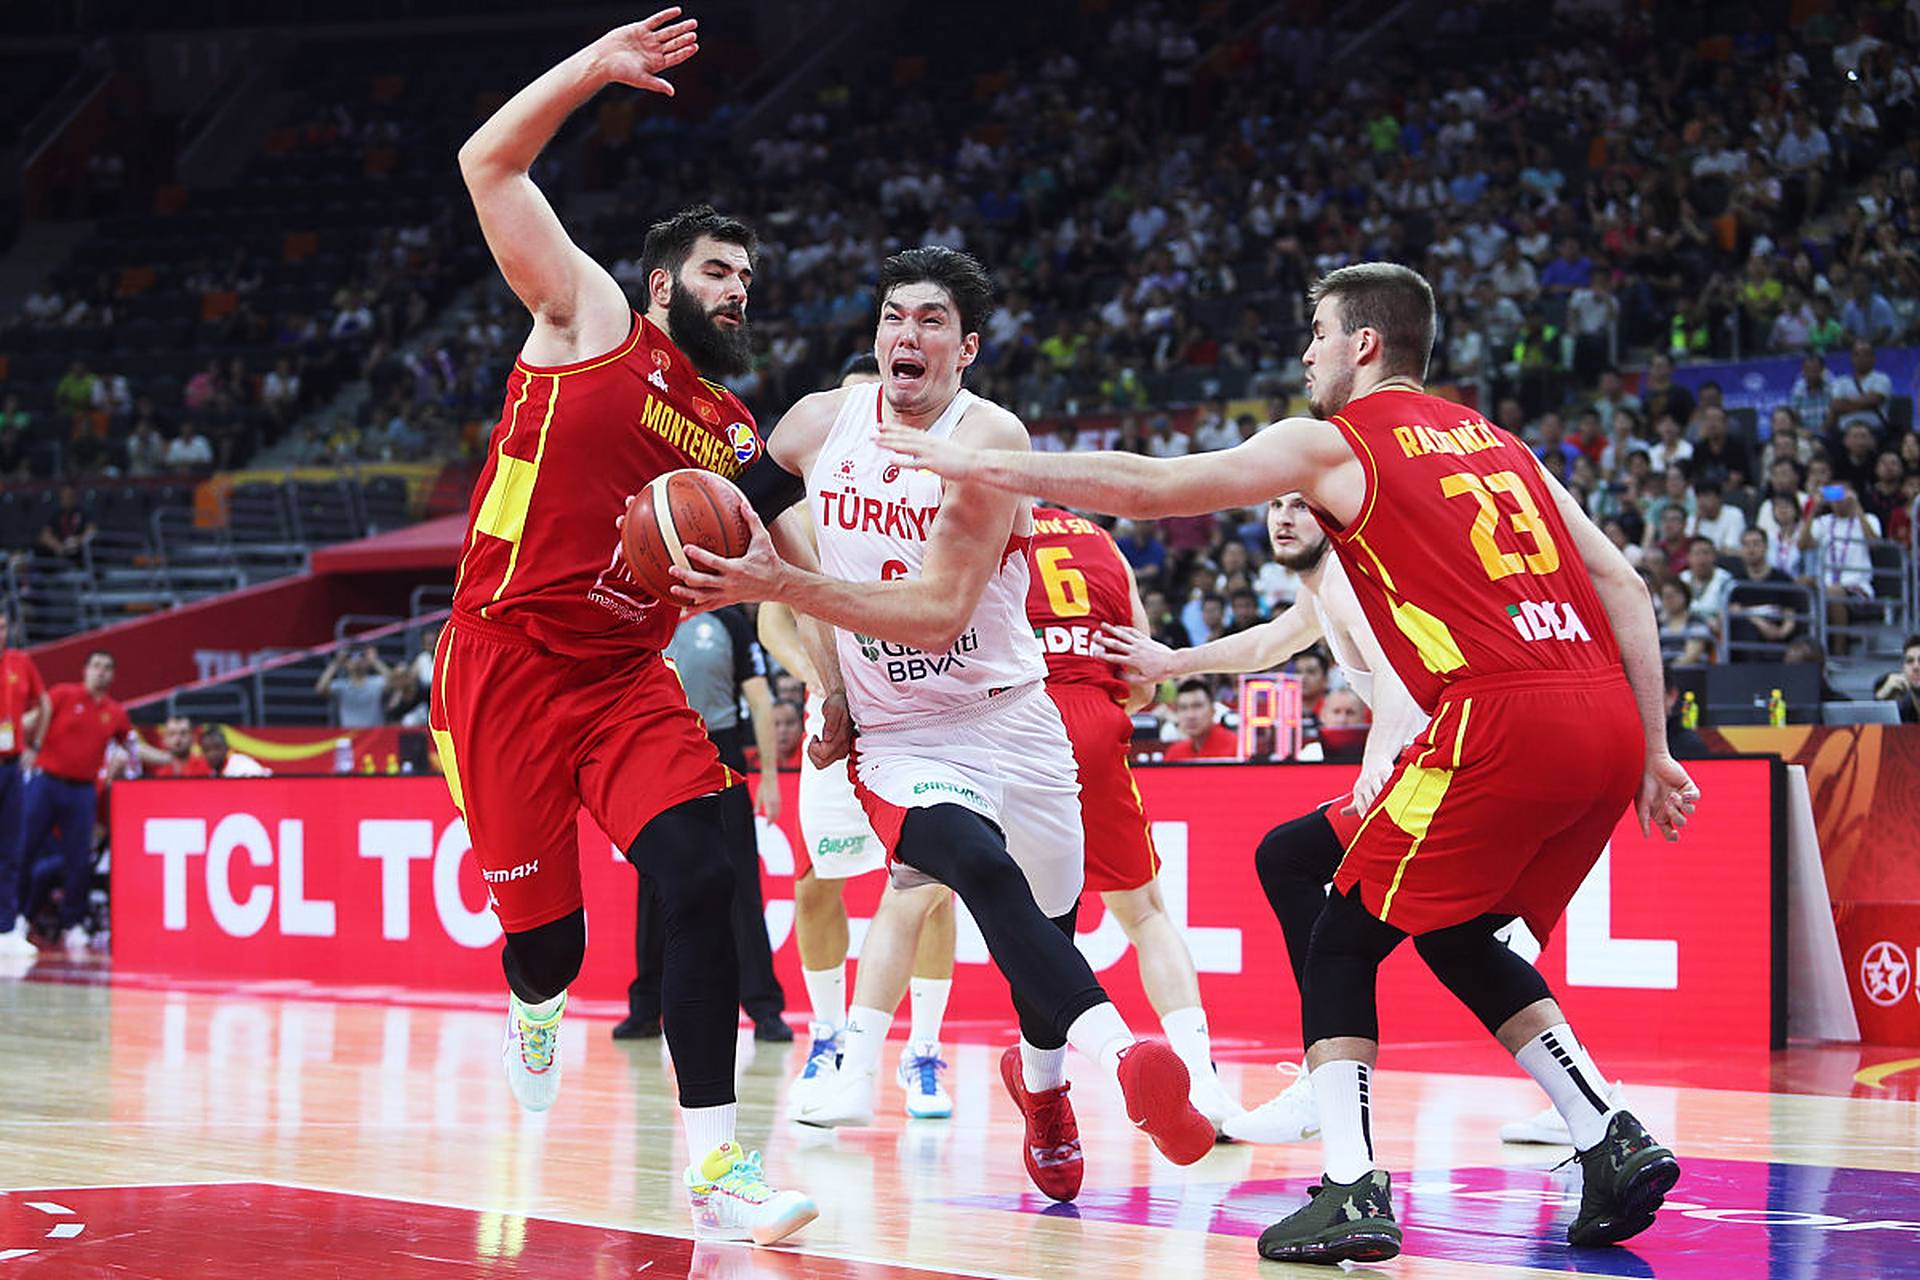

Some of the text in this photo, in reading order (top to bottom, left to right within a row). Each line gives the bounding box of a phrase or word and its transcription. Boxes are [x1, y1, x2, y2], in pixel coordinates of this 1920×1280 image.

[1439, 471, 1560, 582] 23
[1035, 546, 1091, 617] 6
[887, 651, 965, 683] BBVA
[144, 813, 335, 938] TCL
